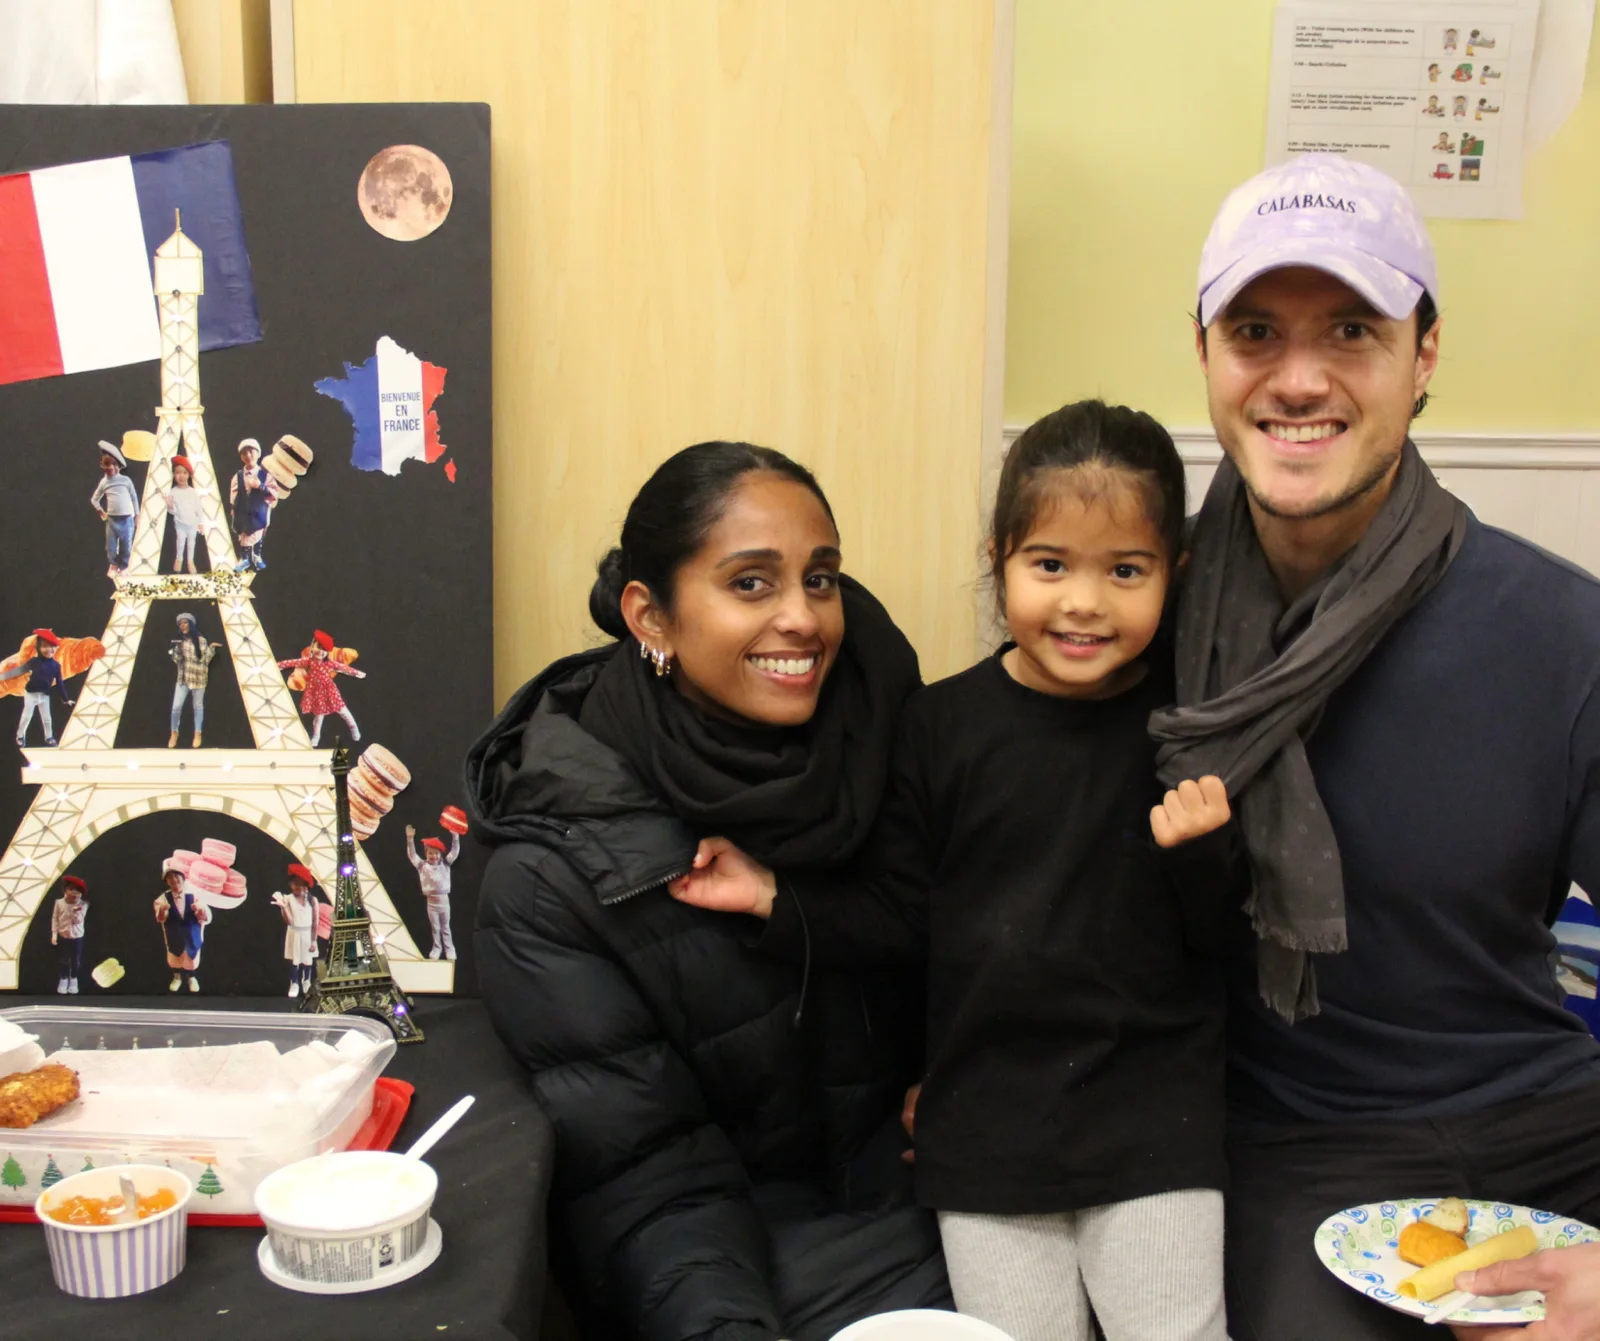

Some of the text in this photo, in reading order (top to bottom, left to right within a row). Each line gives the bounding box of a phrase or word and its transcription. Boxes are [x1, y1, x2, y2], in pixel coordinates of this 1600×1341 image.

[1257, 193, 1357, 216] CALABASAS
[381, 391, 421, 403] BIENVENUE
[396, 405, 408, 417] EN
[383, 418, 421, 432] FRANCE
